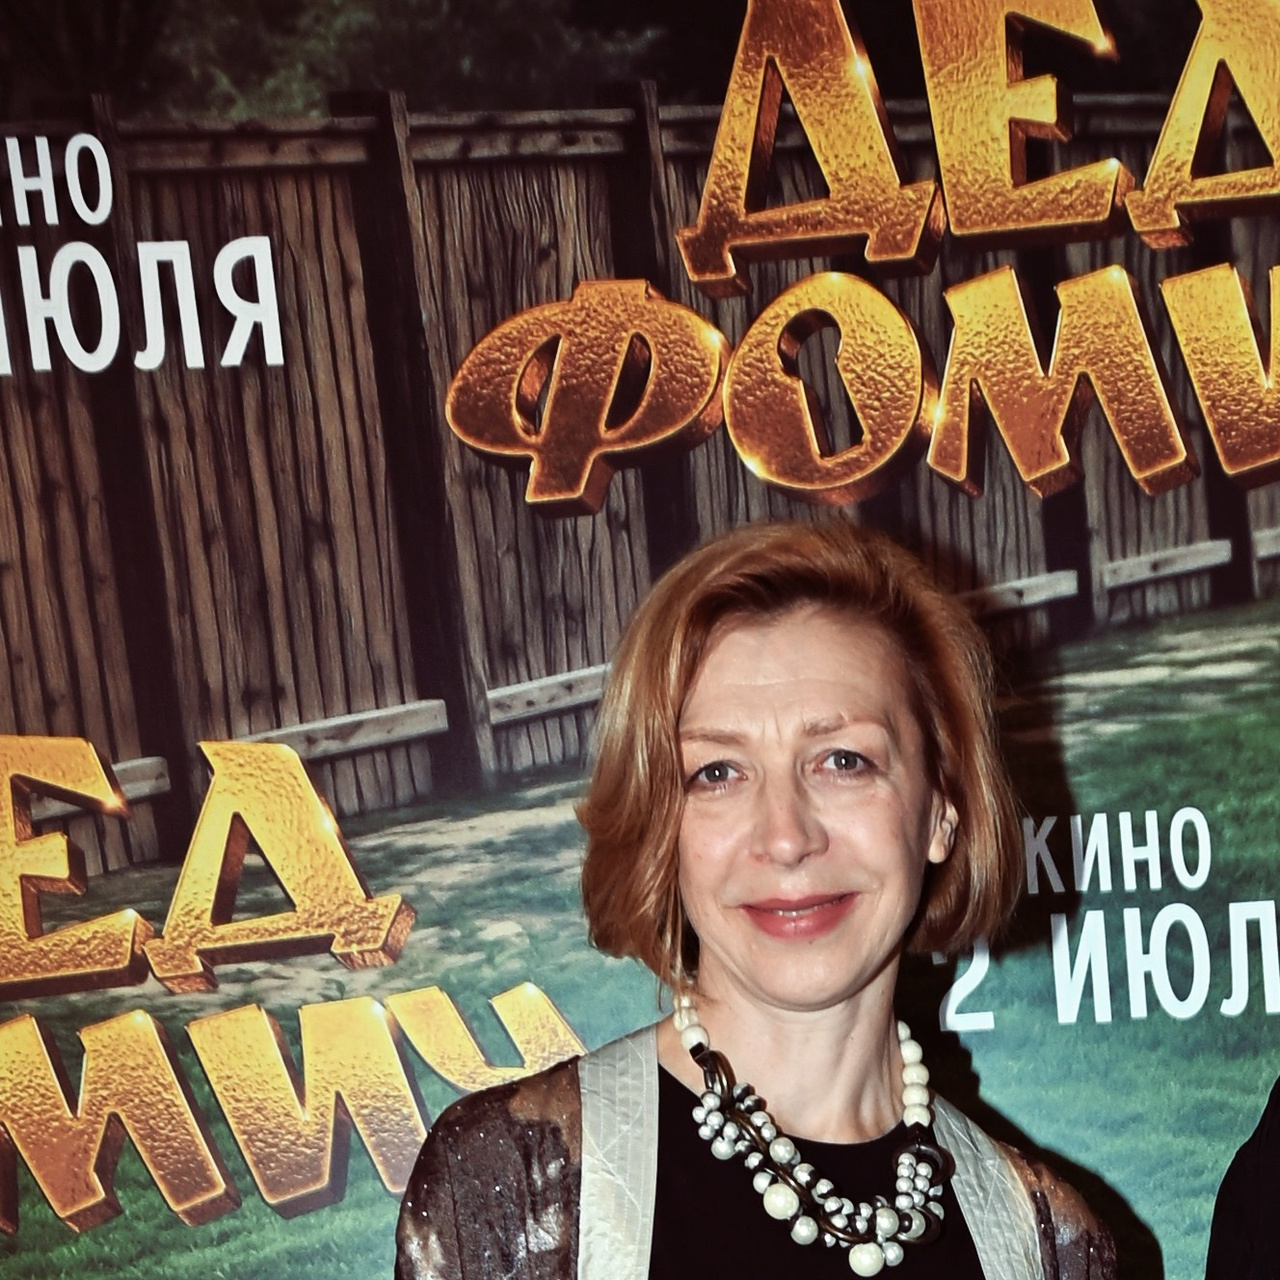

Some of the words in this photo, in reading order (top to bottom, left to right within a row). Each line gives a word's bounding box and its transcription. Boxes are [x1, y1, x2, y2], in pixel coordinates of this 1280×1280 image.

[0, 133, 114, 227] НО
[0, 735, 417, 997] ЕД
[1023, 807, 1212, 894] КИНО
[0, 981, 588, 1232] МИЧ
